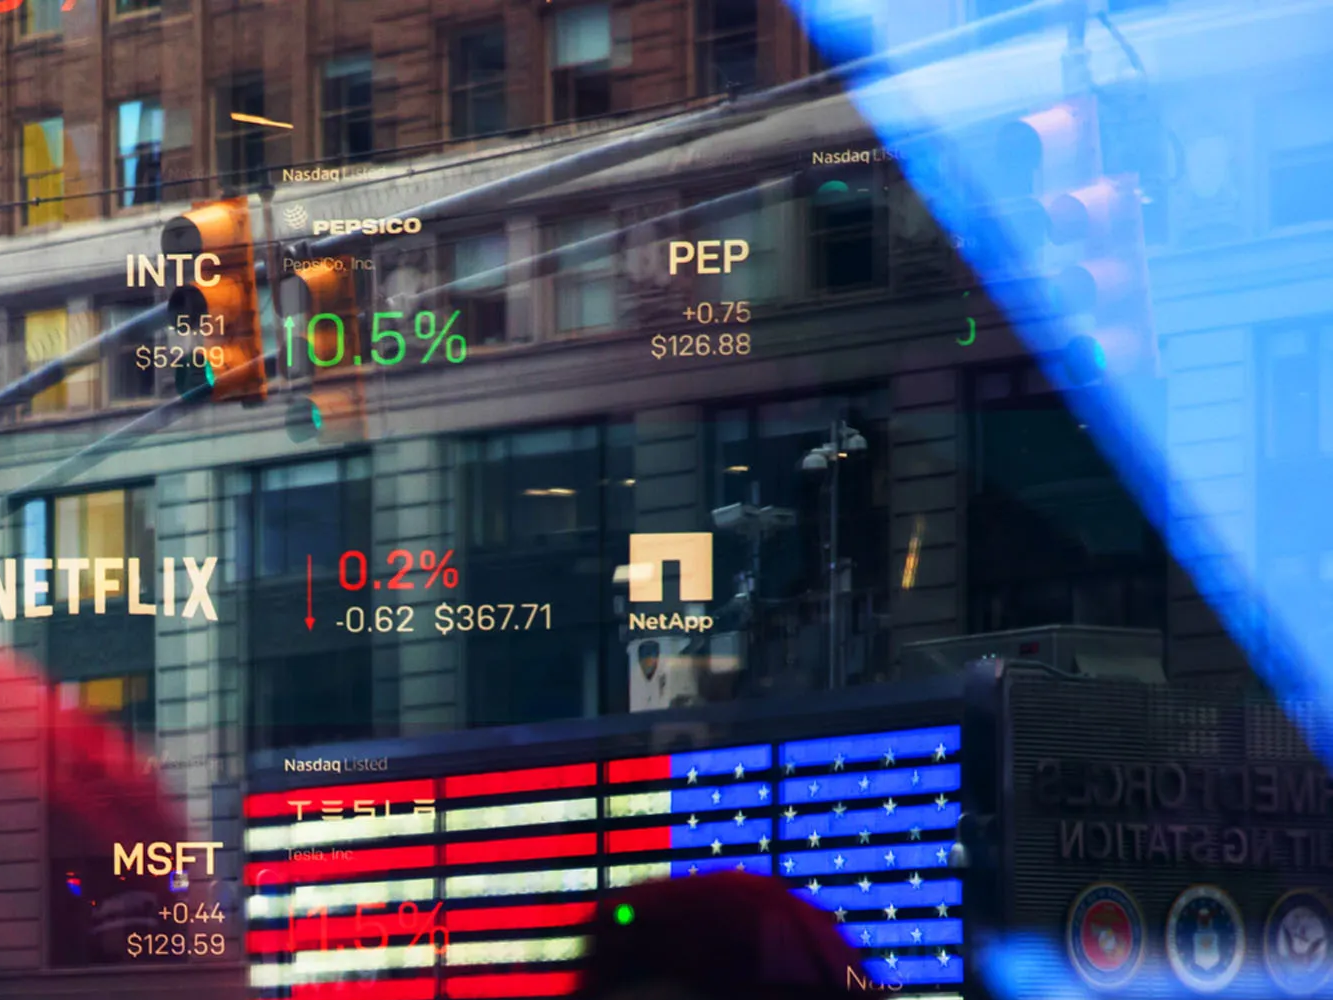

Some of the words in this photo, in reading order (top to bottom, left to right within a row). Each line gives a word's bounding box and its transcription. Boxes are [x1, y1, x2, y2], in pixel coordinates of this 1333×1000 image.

[812, 148, 871, 166] Nasdaq
[283, 167, 340, 184] Nasdaq
[312, 216, 422, 236] PEPSICO
[126, 252, 222, 288] INTC
[669, 238, 751, 276] PEP
[167, 315, 226, 336] -5.51
[682, 300, 752, 325] +0.75
[306, 309, 468, 368] 0.5%
[650, 332, 752, 361] $126.88
[135, 344, 226, 371] $52.09
[338, 549, 460, 593] 0.2%
[335, 604, 415, 635] -0.62
[433, 602, 553, 637] $367.71
[629, 612, 714, 635] NetApp
[283, 757, 341, 775] Nasdaq
[343, 757, 388, 773] Listed
[286, 799, 436, 822] TESLA
[113, 840, 224, 877] MSFT
[157, 901, 226, 925] +0.44
[126, 931, 226, 958] $129.59
